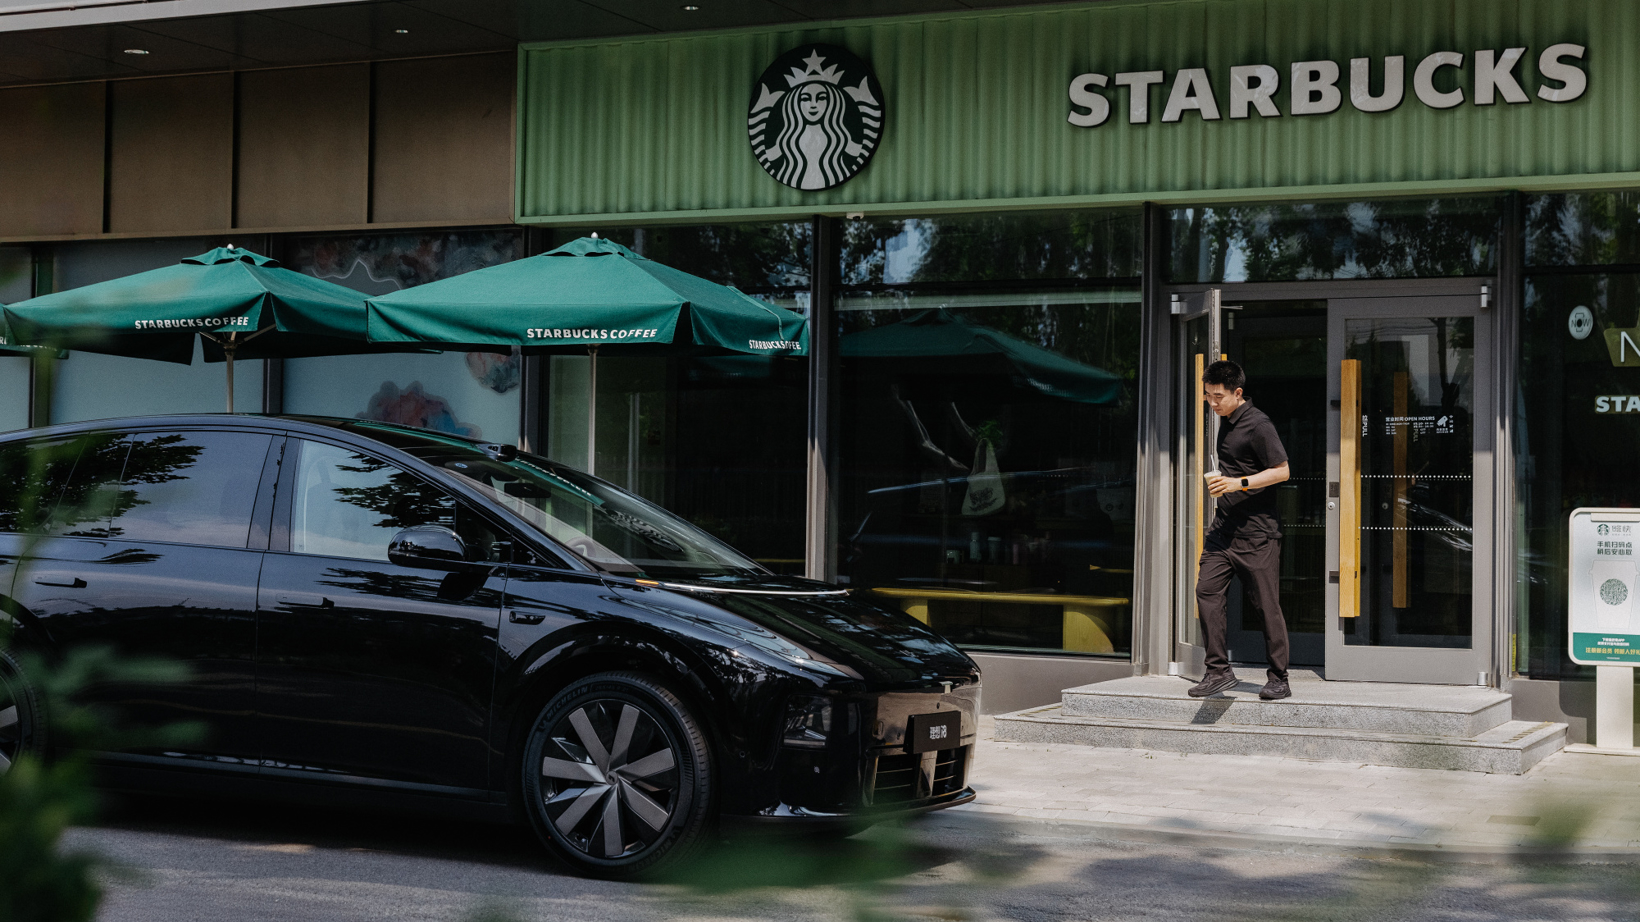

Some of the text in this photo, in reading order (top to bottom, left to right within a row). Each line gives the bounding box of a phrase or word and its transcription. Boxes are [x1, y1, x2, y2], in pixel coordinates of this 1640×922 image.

[1067, 43, 1588, 128] STARBUCKS
[134, 316, 249, 330] STARBUCKS COFFEE
[526, 328, 658, 340] STARBUCKS COFFEE
[748, 339, 785, 350] STARBUCKS
[546, 684, 588, 721] MICHELIN
